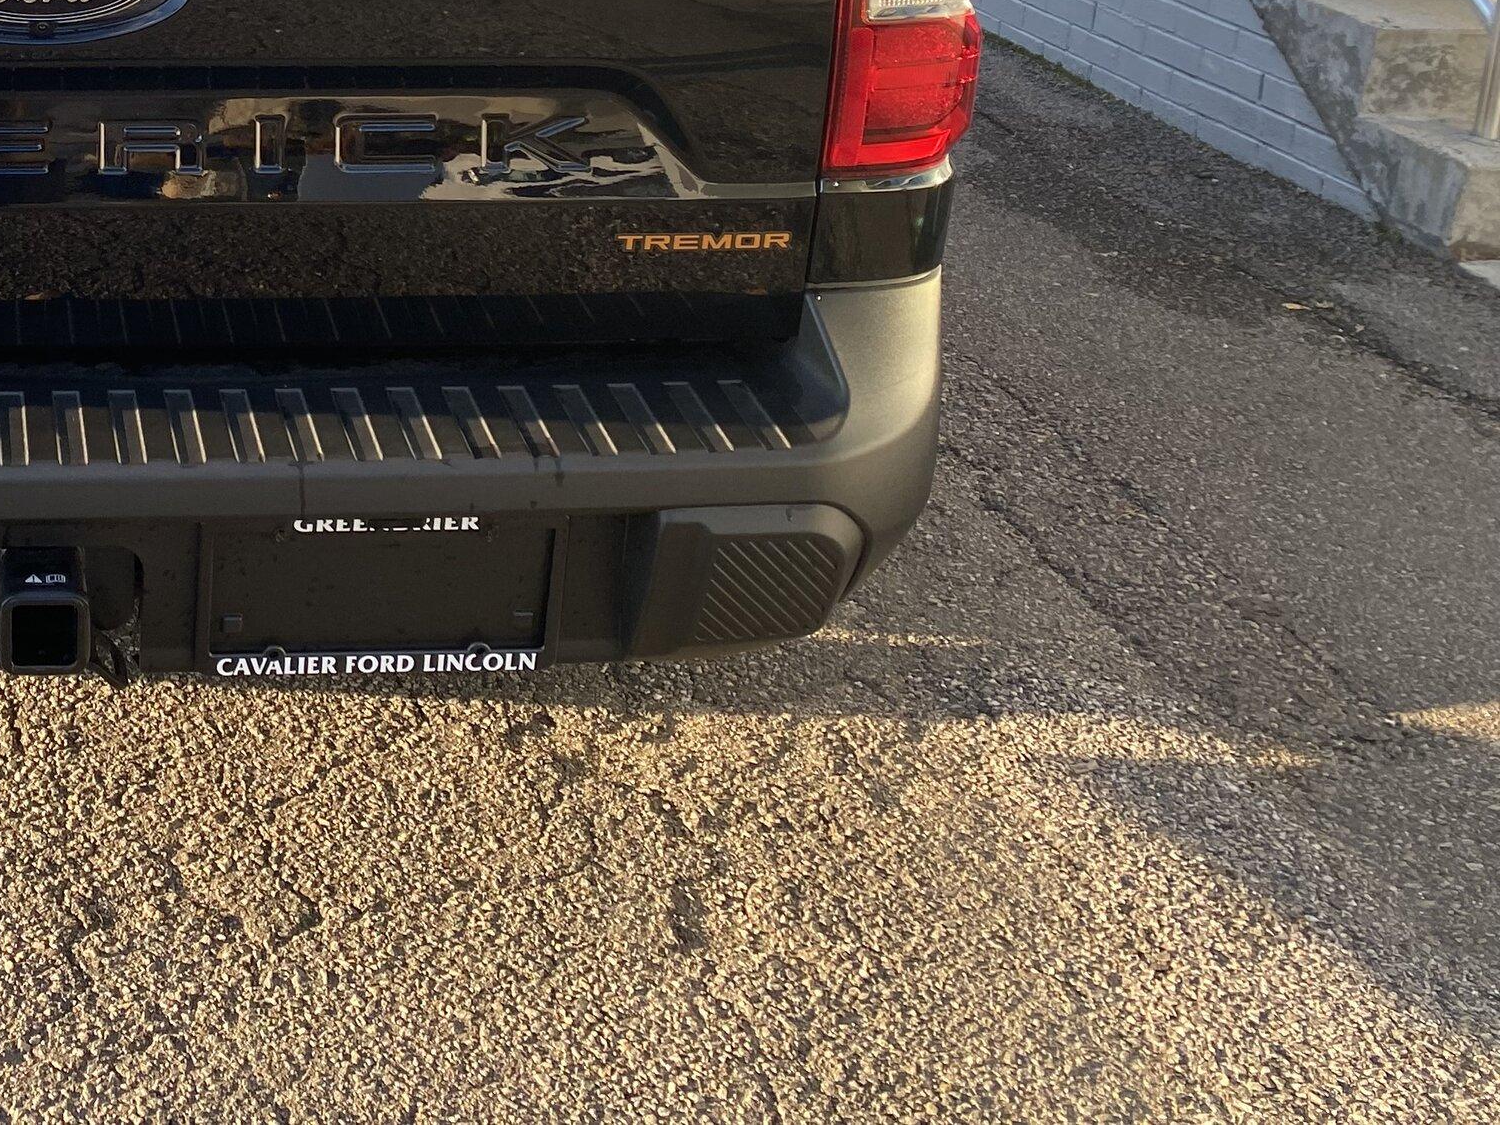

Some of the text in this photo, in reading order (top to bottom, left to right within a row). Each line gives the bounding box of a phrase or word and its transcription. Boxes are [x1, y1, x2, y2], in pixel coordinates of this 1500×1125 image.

[617, 232, 791, 251] TREMOR
[293, 517, 479, 533] GREERIER
[216, 652, 537, 676] CAVALIER FORD LINCOLN
